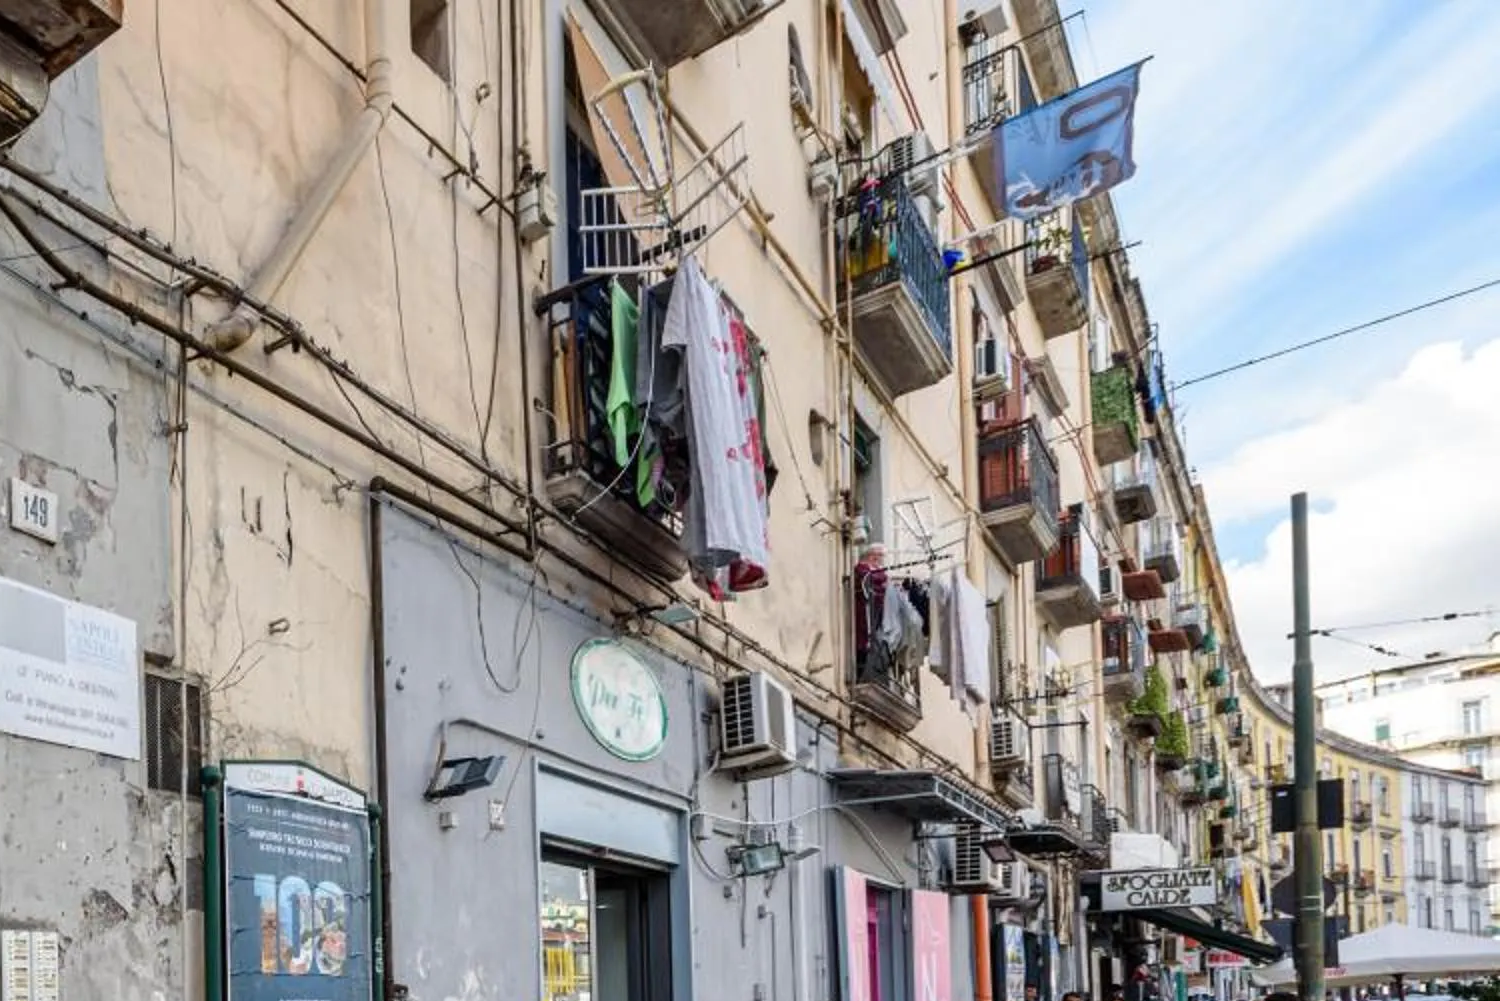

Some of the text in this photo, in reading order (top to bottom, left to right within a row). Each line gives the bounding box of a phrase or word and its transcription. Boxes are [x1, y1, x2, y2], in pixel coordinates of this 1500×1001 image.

[23, 494, 49, 528] 149
[1107, 870, 1212, 892] SFOGLIATE
[1127, 888, 1191, 907] CALDE
